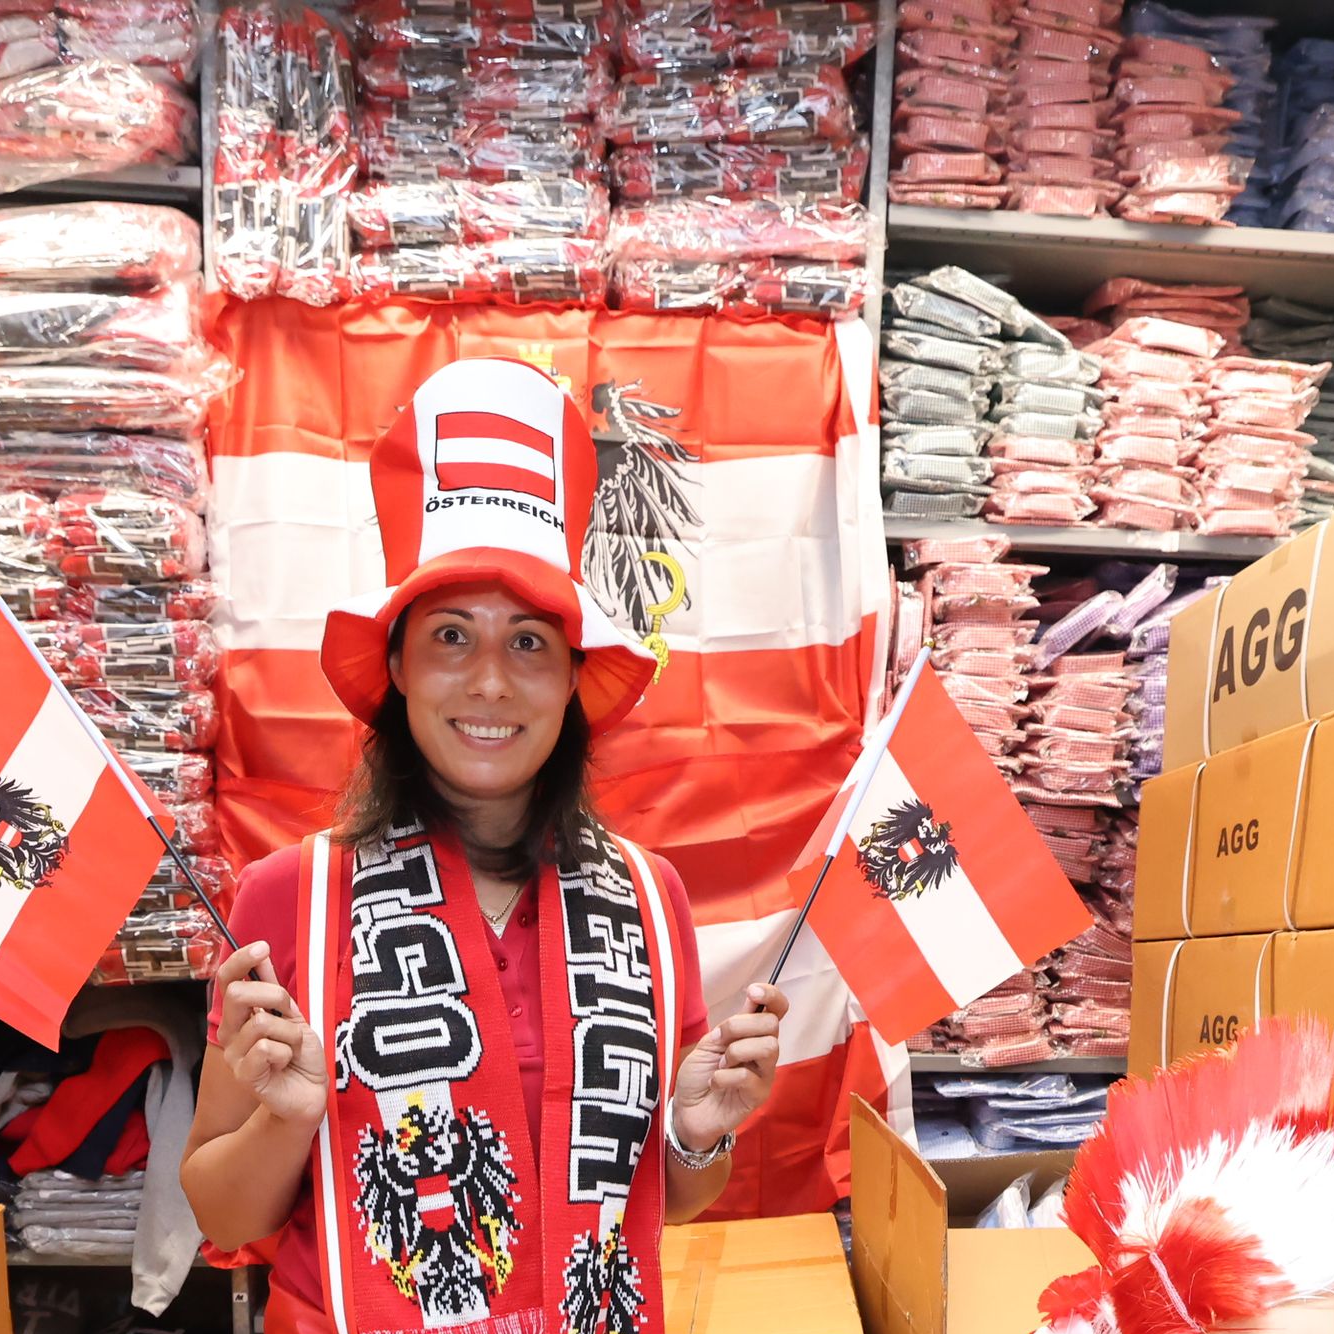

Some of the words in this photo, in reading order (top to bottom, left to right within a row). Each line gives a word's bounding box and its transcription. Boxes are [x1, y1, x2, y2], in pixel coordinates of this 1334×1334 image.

[425, 494, 565, 533] ÖSTERREICH
[1213, 589, 1306, 703] AGG
[1217, 819, 1258, 858] AGG
